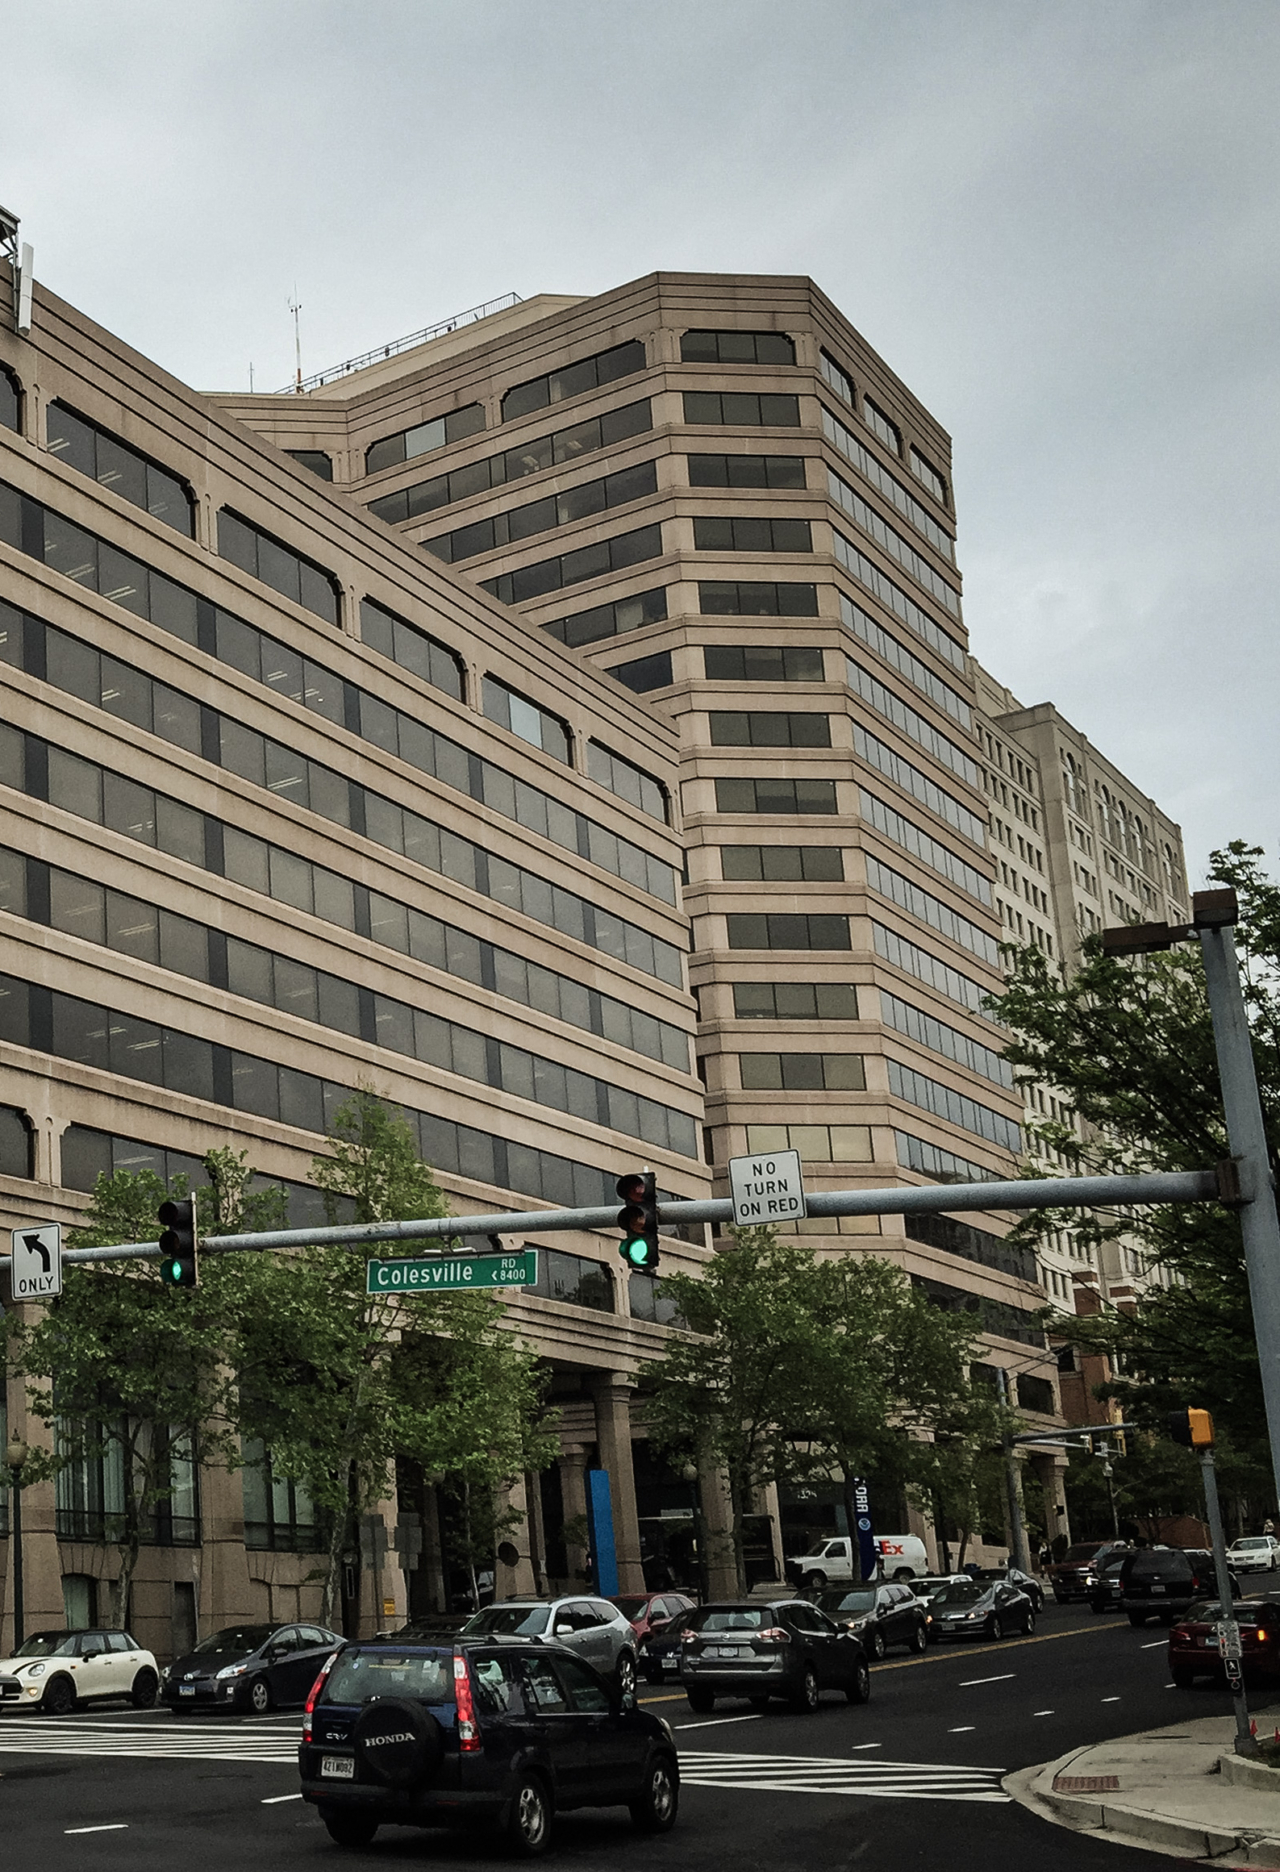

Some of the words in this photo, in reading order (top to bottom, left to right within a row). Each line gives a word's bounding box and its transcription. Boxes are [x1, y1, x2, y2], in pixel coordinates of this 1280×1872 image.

[752, 1161, 776, 1177] NO
[744, 1178, 789, 1197] TURN
[739, 1201, 761, 1217] ON
[767, 1197, 799, 1214] RED
[501, 1258, 516, 1269] RD
[377, 1262, 473, 1285] Colesville
[499, 1268, 526, 1281] 8400
[18, 1275, 55, 1293] ONLY
[365, 1732, 416, 1747] HONDA
